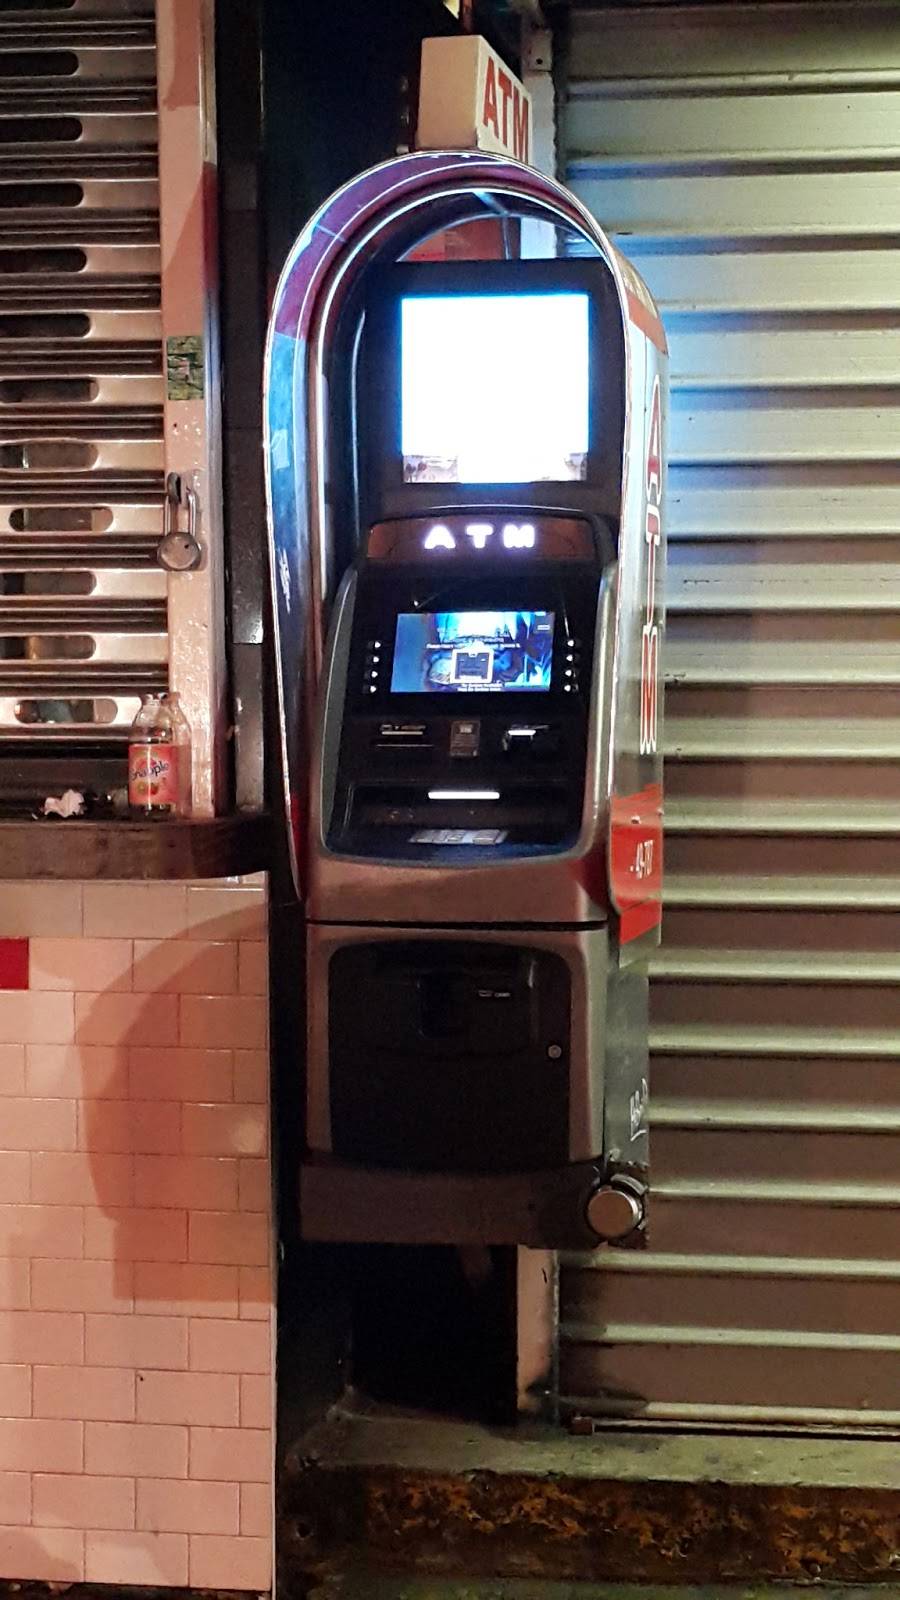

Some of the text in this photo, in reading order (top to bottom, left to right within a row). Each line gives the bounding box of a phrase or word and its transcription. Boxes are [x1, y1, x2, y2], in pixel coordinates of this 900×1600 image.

[483, 56, 529, 165] ATM
[424, 523, 535, 549] ATM
[640, 374, 661, 755] ATM
